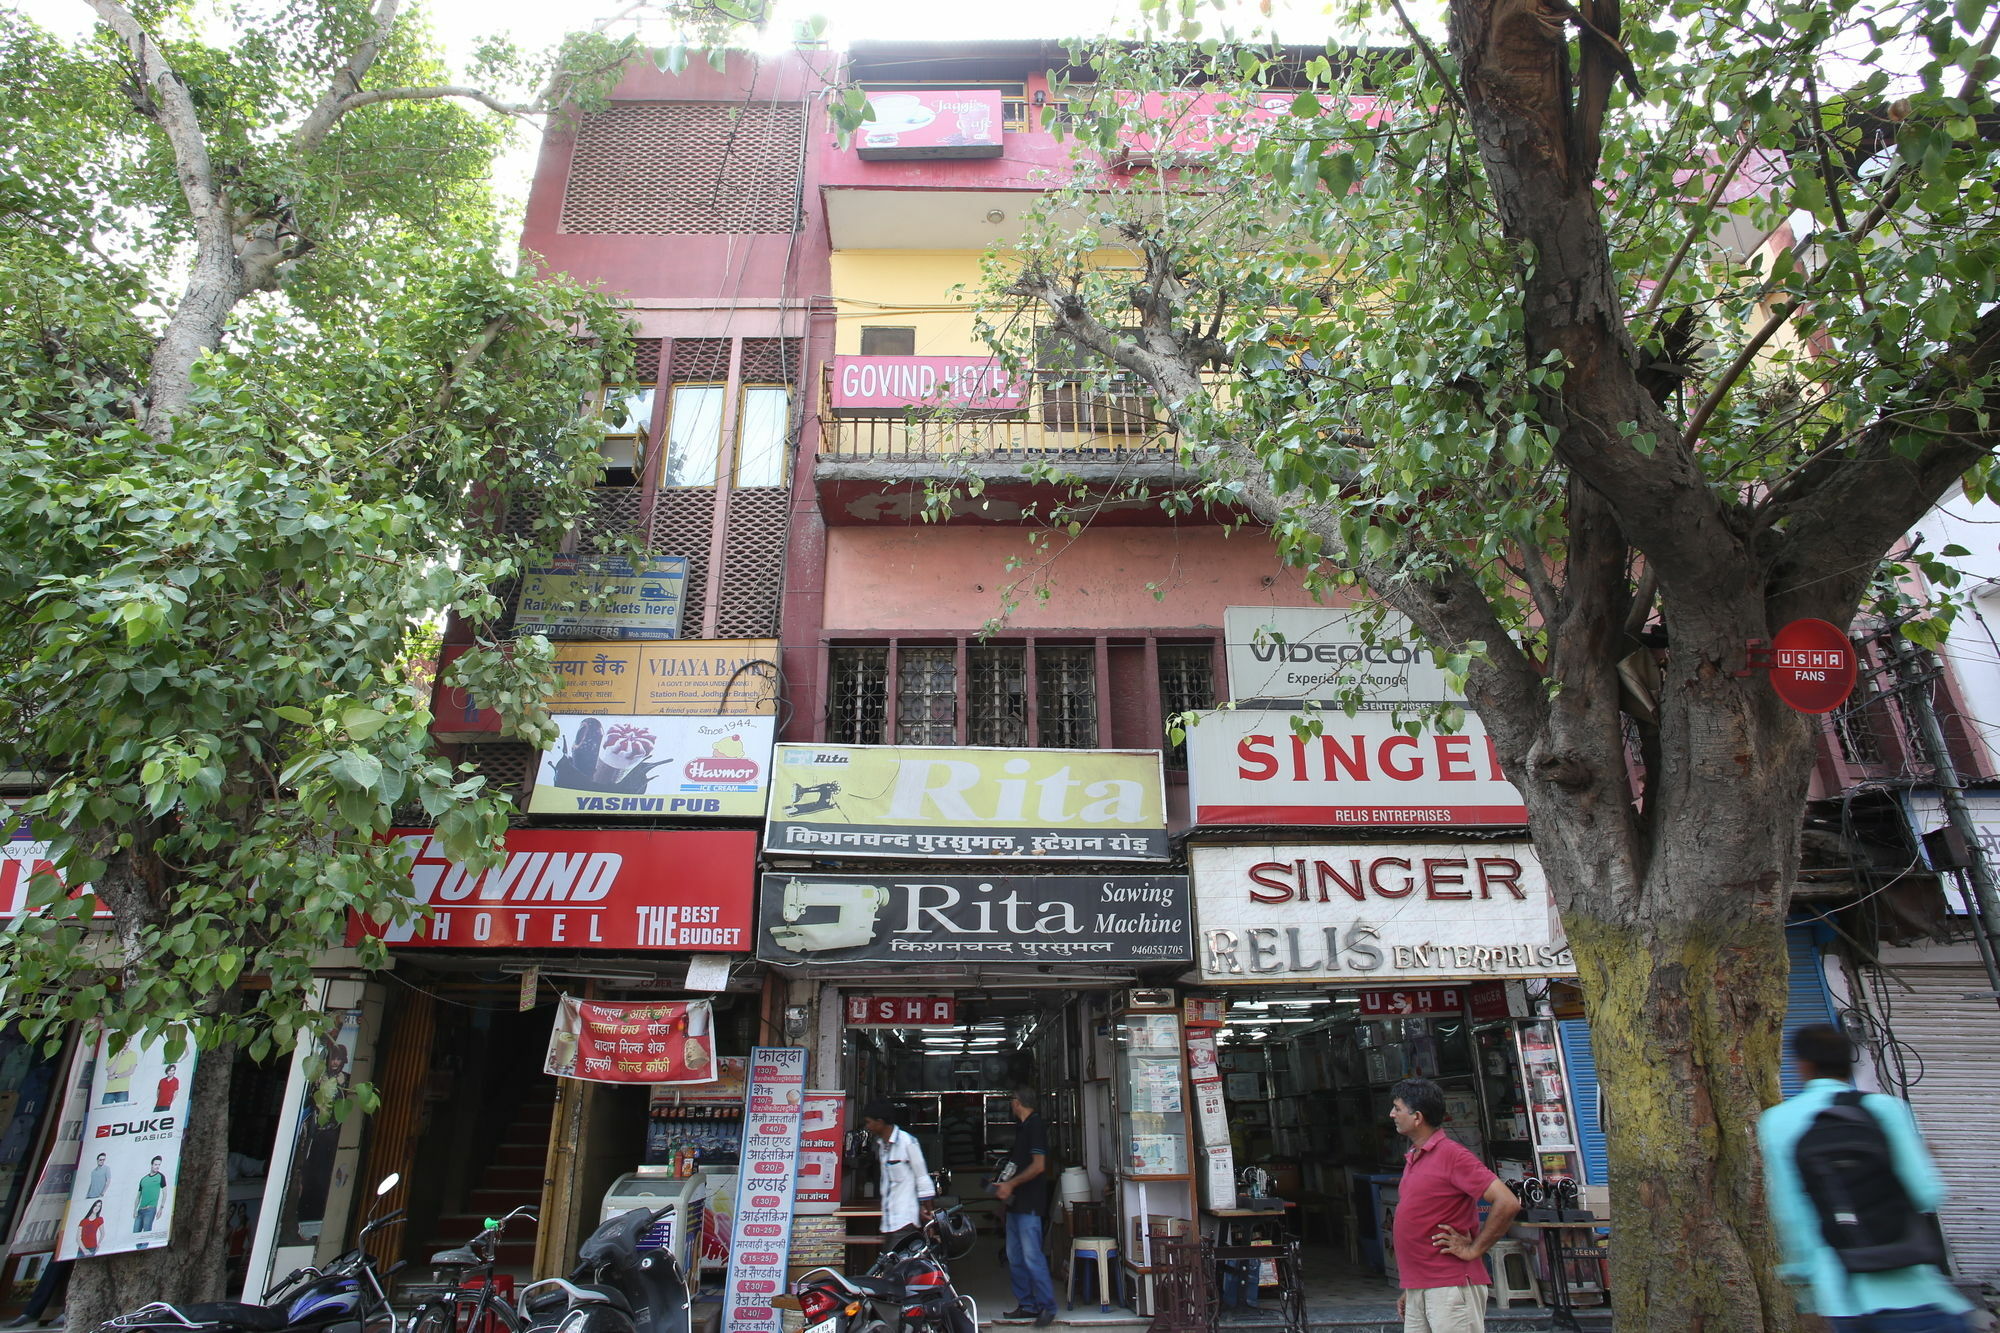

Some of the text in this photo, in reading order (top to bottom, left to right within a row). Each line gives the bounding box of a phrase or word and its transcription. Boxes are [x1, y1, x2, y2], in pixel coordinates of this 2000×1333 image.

[843, 364, 1020, 399] GOVIND HOTEL
[645, 601, 675, 615] here
[591, 653, 627, 676] बैंक
[649, 658, 709, 677] VIJAYA
[1780, 651, 1840, 667] USHA
[1287, 673, 1408, 687] Experiene Change
[1795, 670, 1826, 682] FANS
[678, 691, 700, 699] Road,
[733, 690, 759, 698] Branch
[698, 725, 724, 736] Since
[814, 754, 849, 763] Rita
[689, 761, 754, 779] Havmor
[880, 758, 1148, 824] Rita
[576, 796, 721, 812] YASHVI PUB
[1335, 809, 1451, 823] RELIS ENTREPRISES
[786, 825, 913, 848] किशनचन्द
[1030, 832, 1105, 851] स्टेशन
[390, 834, 623, 906] GOVIND
[1247, 856, 1528, 904] SINGER
[893, 881, 1175, 934] Rita Sawing
[433, 913, 603, 942] HOTEL
[636, 906, 720, 946] THE BEST
[1094, 912, 1183, 935] Machine
[679, 927, 741, 945] BUDGET
[889, 938, 1115, 956] किशनचन्द पुरसुमल
[1131, 944, 1184, 955] 9460551705
[1204, 925, 1384, 975] RELIS
[1366, 989, 1459, 1011] USHA
[1473, 989, 1502, 1005] SINGER
[592, 1005, 624, 1022] फालूदा
[852, 1002, 949, 1019] USHA
[594, 1038, 665, 1054] बादाम मिल्क शेक
[585, 1055, 670, 1073] कुल्फी कोल्ड कॉफी
[757, 1049, 803, 1068] फालूदा
[134, 1131, 174, 1143] BASICS
[747, 1173, 790, 1194] ठण्डाई
[1574, 1248, 1599, 1257] ZEENA
